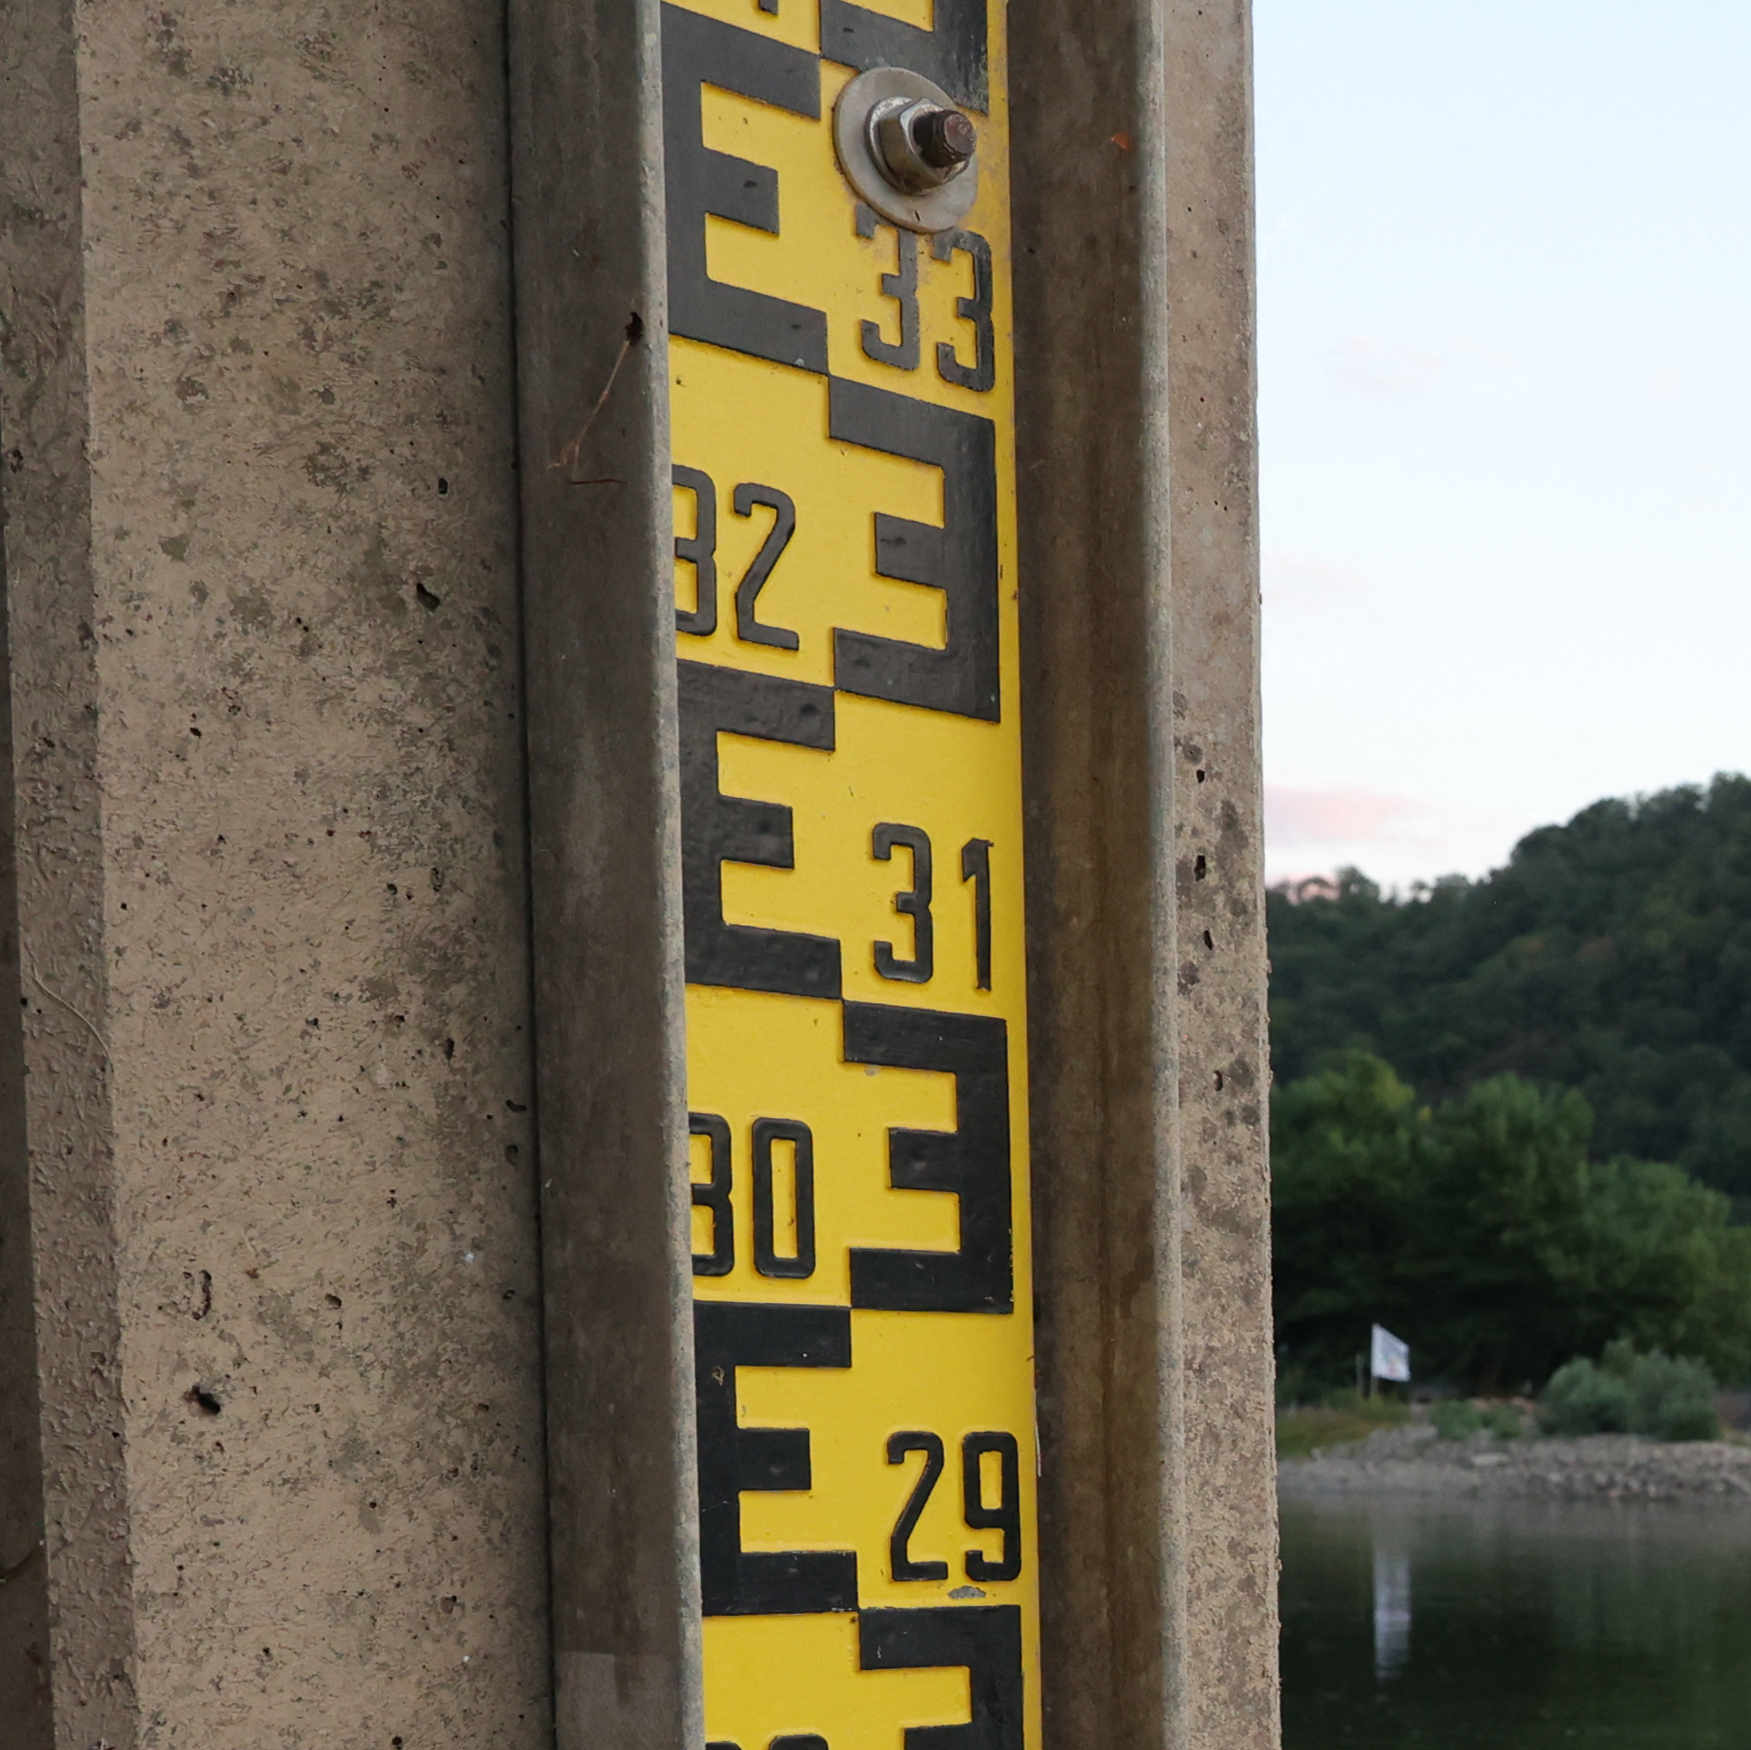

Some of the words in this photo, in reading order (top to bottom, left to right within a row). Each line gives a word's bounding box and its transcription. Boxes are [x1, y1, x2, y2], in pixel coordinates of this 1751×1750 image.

[855, 202, 995, 392] 33
[672, 463, 799, 652] 32
[872, 822, 994, 992] 31
[688, 1112, 815, 1280] 30
[887, 1430, 1022, 1582] 29
